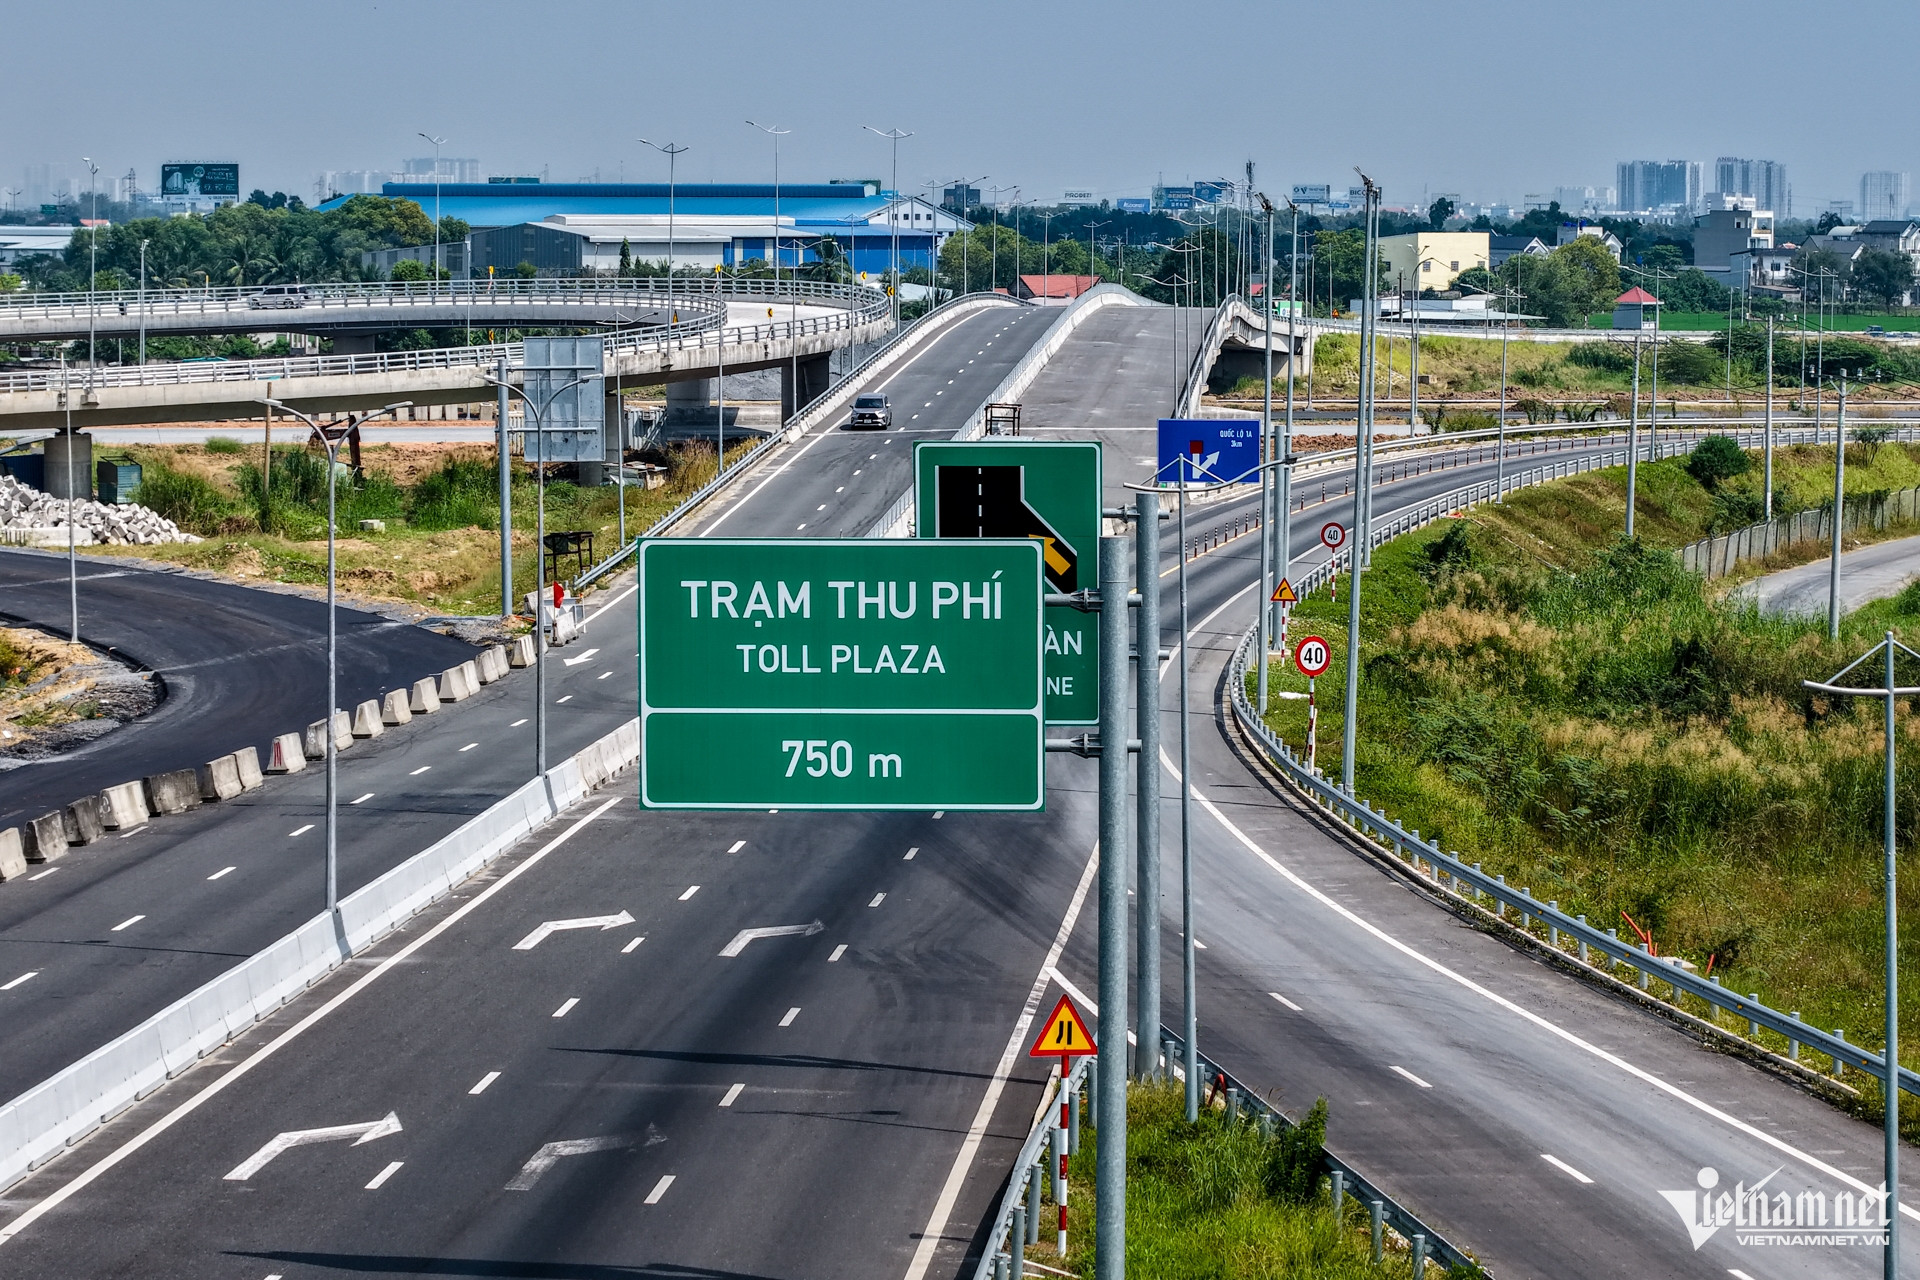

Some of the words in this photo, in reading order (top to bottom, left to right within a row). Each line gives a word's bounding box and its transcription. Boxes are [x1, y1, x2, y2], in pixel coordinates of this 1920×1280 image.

[1219, 428, 1235, 438] QUỐC
[1245, 430, 1253, 438] 1A
[1230, 440, 1243, 448] 3km
[1327, 529, 1338, 541] 40
[680, 580, 811, 628] TRẠM
[827, 581, 917, 619] THU
[932, 570, 1003, 619] PHÍ
[1044, 624, 1082, 655] ÀN
[736, 644, 821, 673] TOLL
[831, 644, 946, 674] PLAZA
[1304, 647, 1323, 664] 40
[1046, 676, 1074, 696] NE
[782, 740, 853, 778] 750
[868, 753, 902, 778] m
